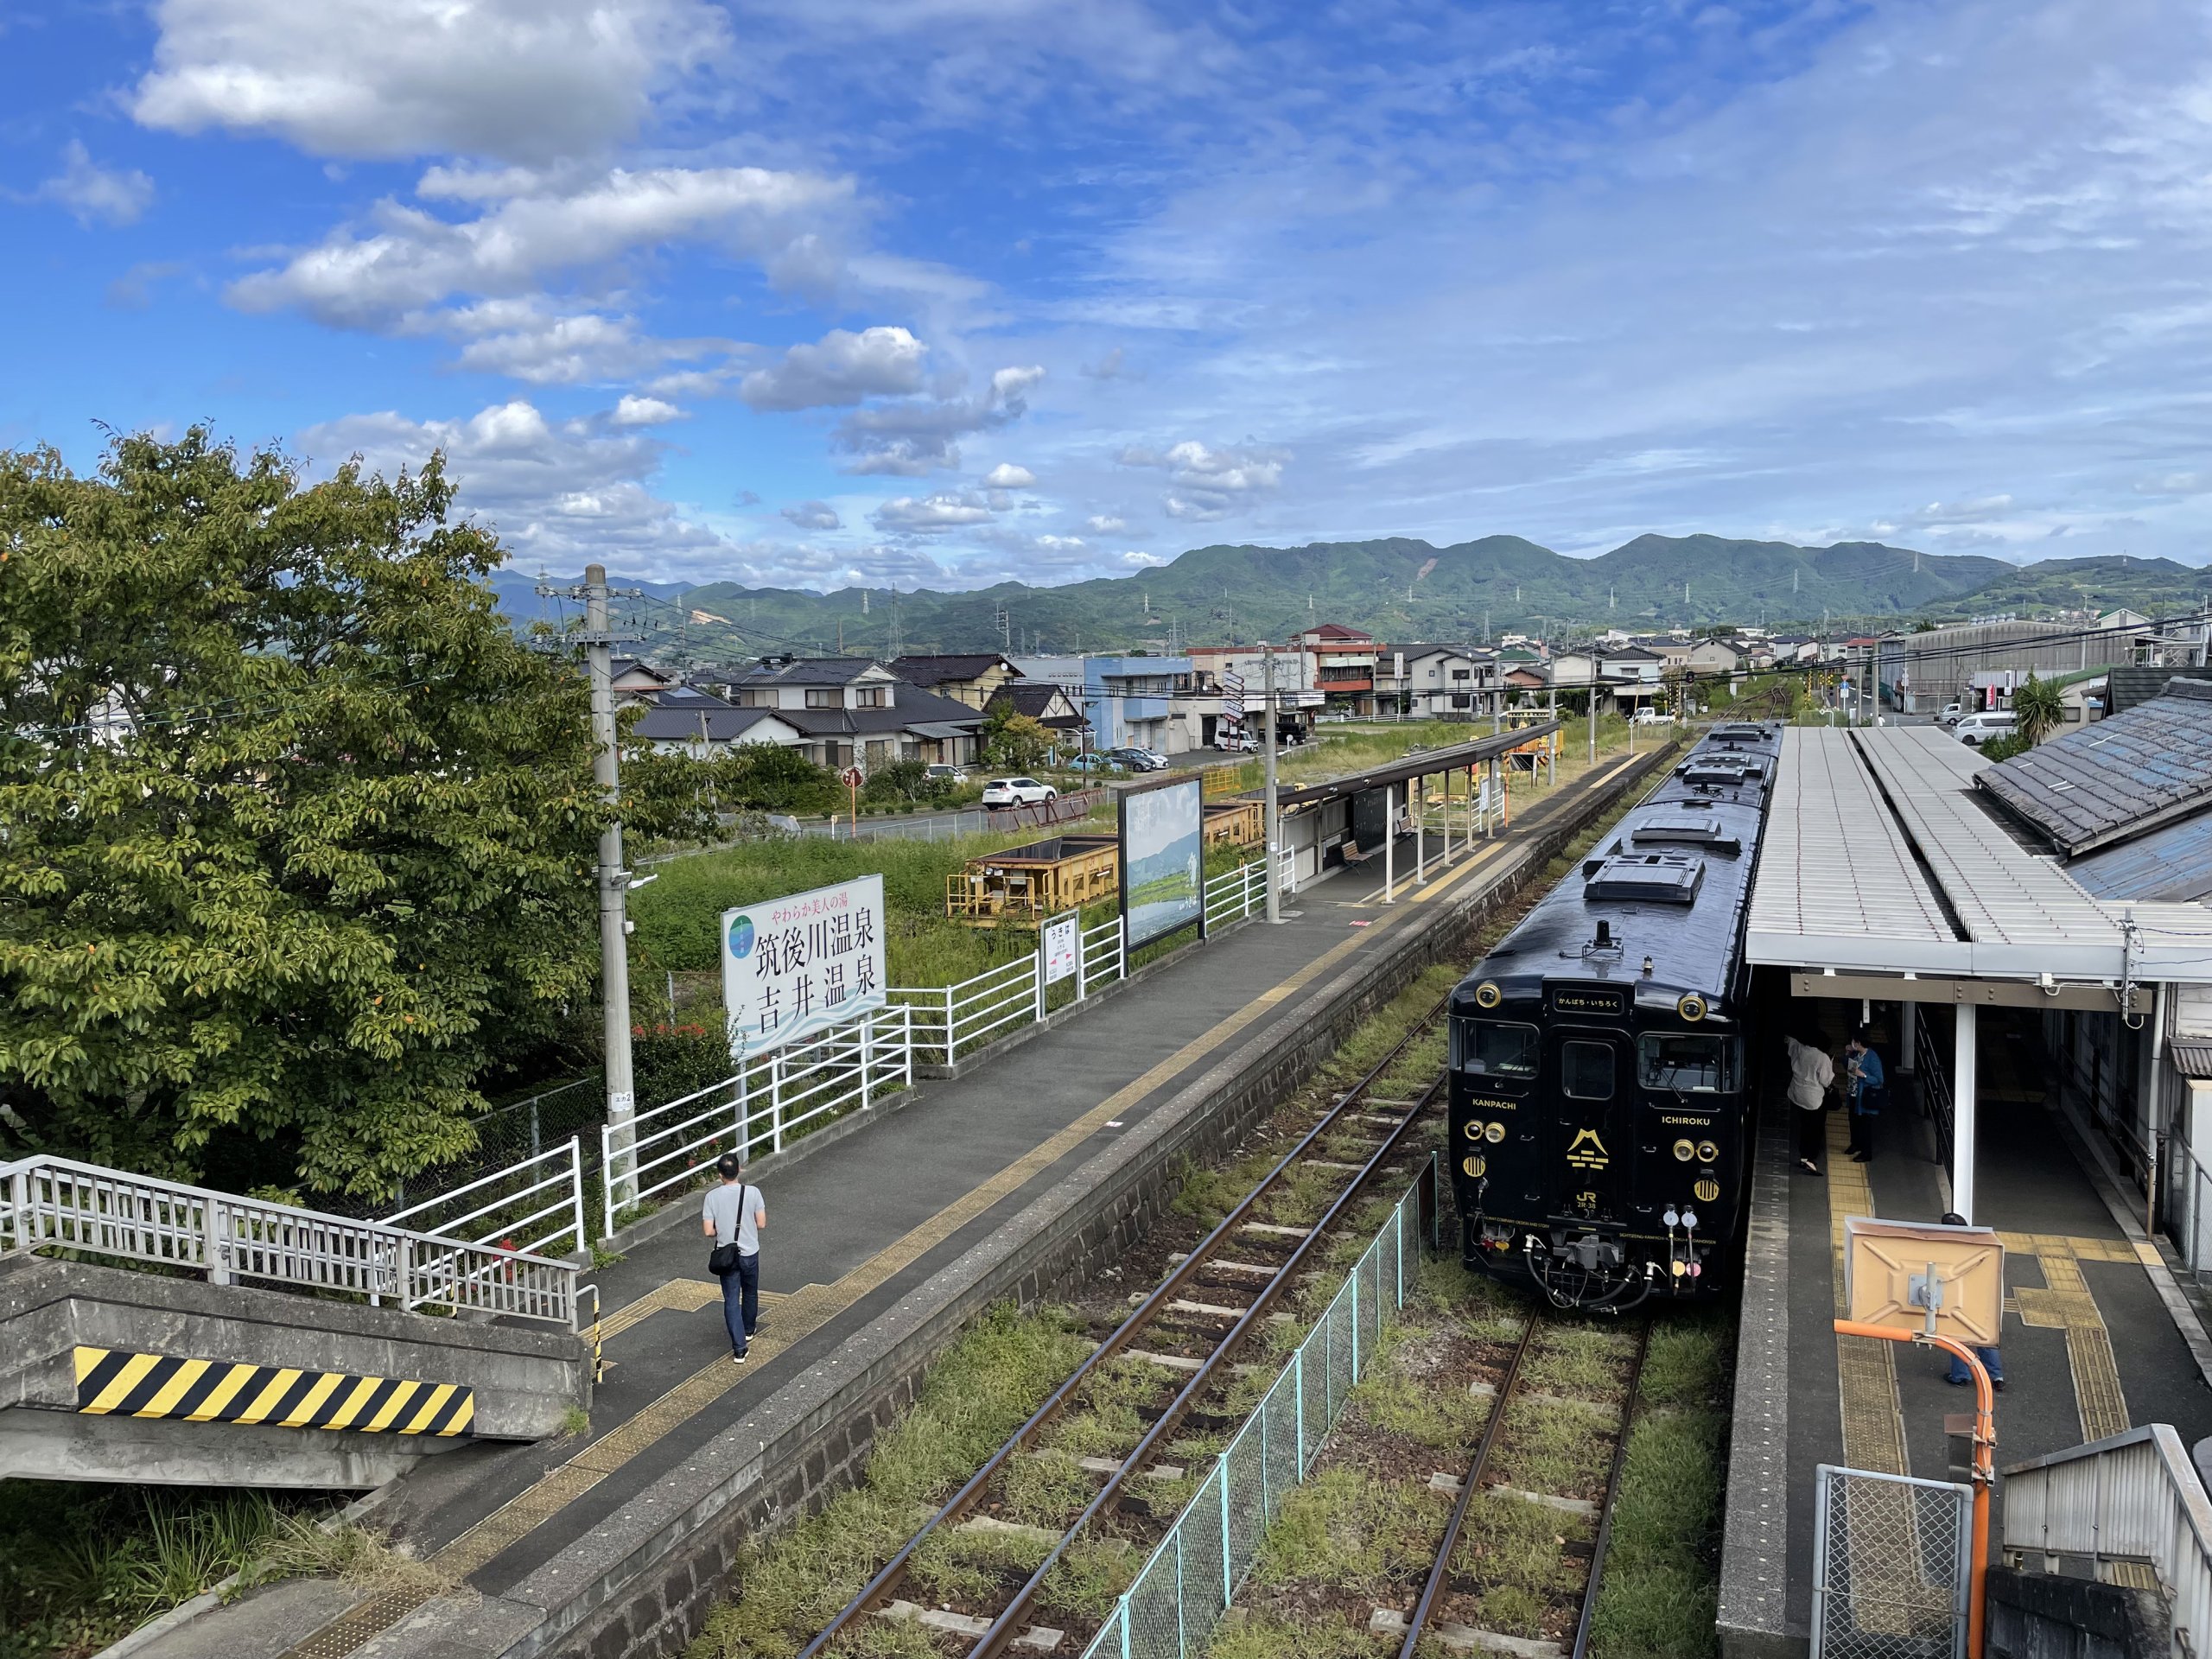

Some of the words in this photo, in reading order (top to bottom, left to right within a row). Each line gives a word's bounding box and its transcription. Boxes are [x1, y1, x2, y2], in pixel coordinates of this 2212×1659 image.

[772, 892, 849, 925] やわらか美人の湯
[1051, 925, 1070, 940] うきは
[755, 906, 874, 982] 筑後川温泉
[757, 954, 875, 1034] 吉井温泉
[1472, 1098, 1516, 1110] KANPACHI
[1662, 1116, 1711, 1126] ICHIROKU
[1576, 1192, 1596, 1203] JR
